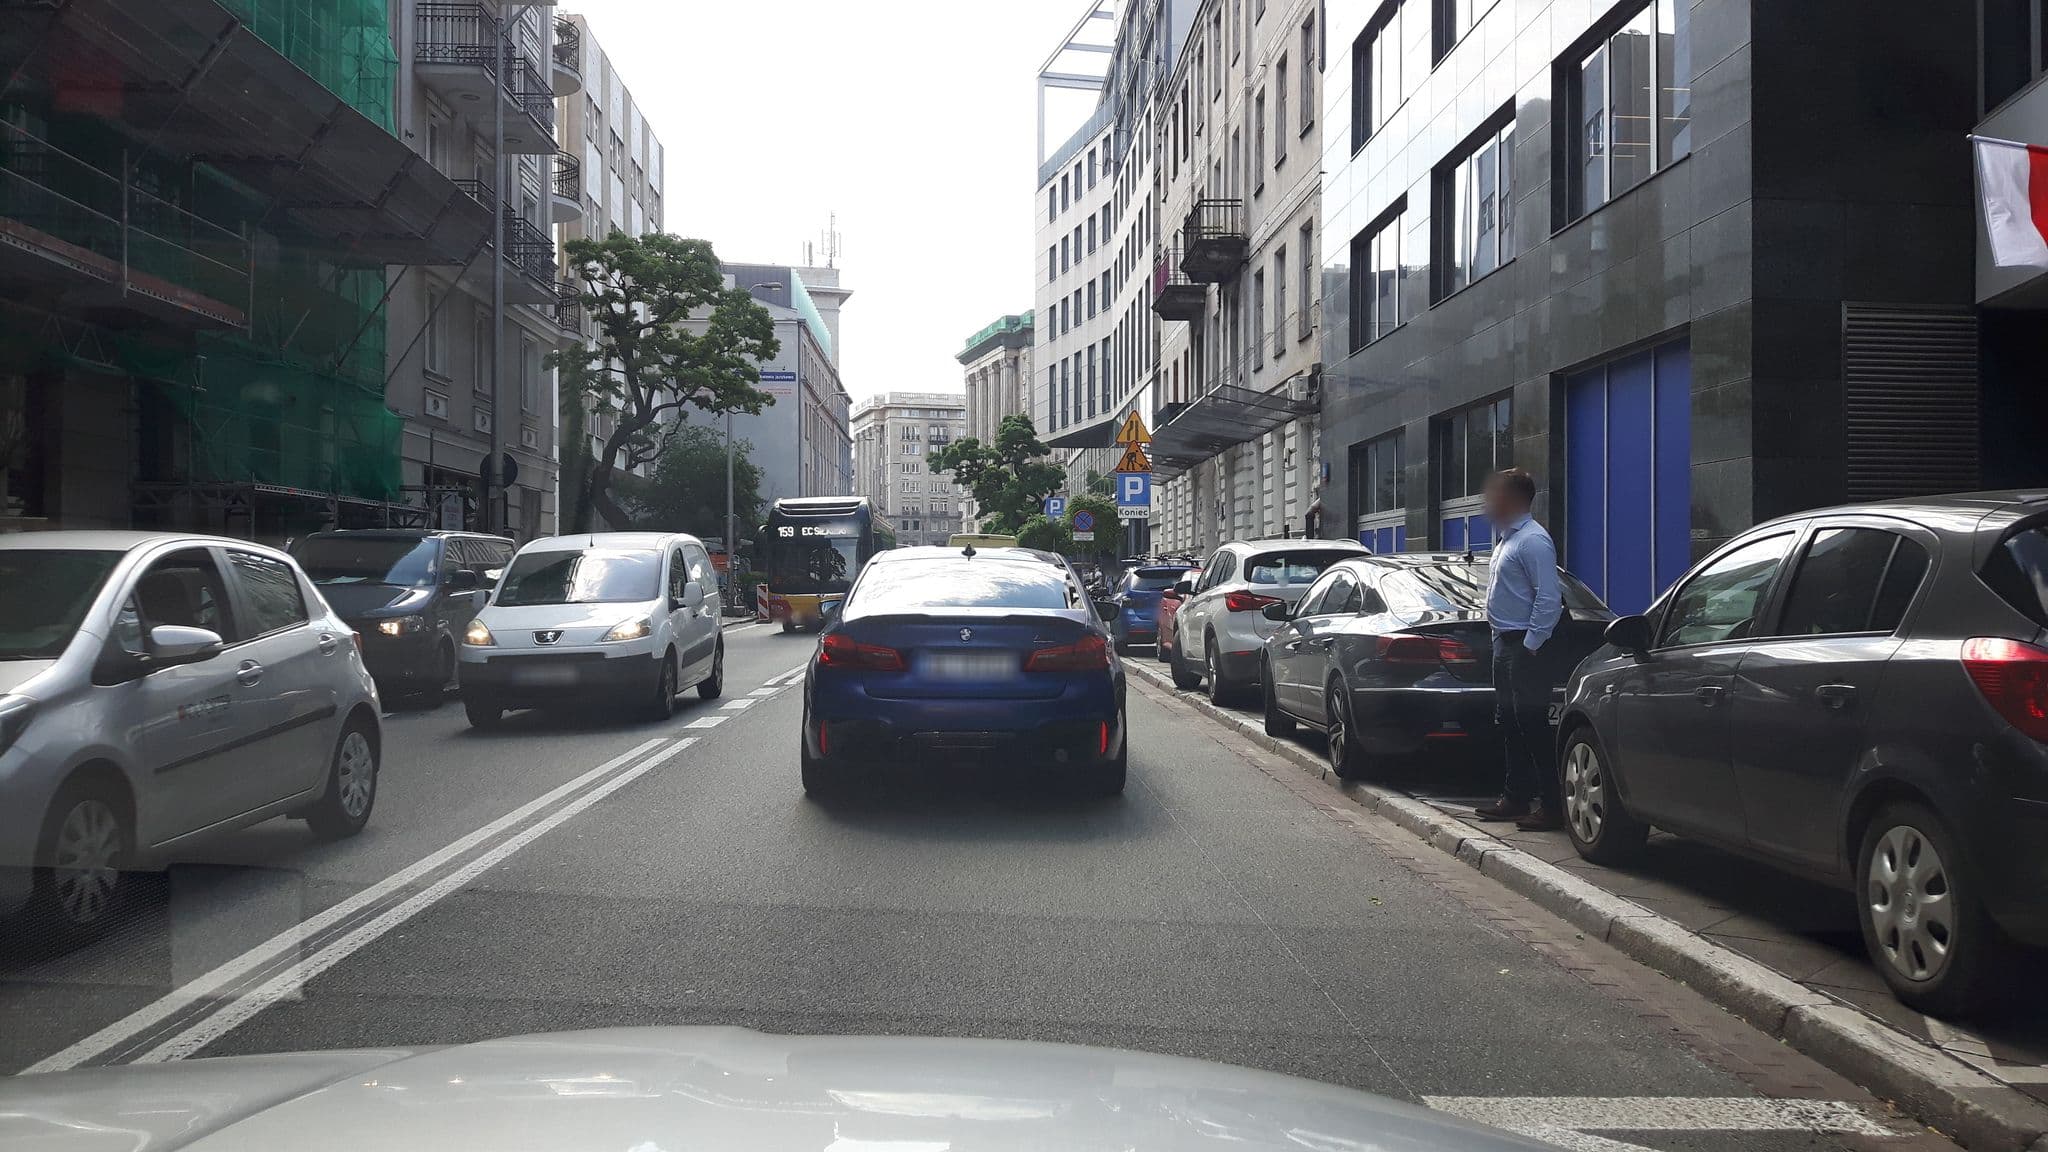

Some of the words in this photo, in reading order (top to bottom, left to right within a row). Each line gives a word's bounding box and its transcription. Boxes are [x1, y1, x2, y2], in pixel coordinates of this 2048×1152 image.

[1125, 476, 1144, 502] P
[1050, 499, 1060, 514] P
[1119, 507, 1148, 516] Koniec
[778, 526, 794, 537] 159
[801, 526, 814, 536] EC
